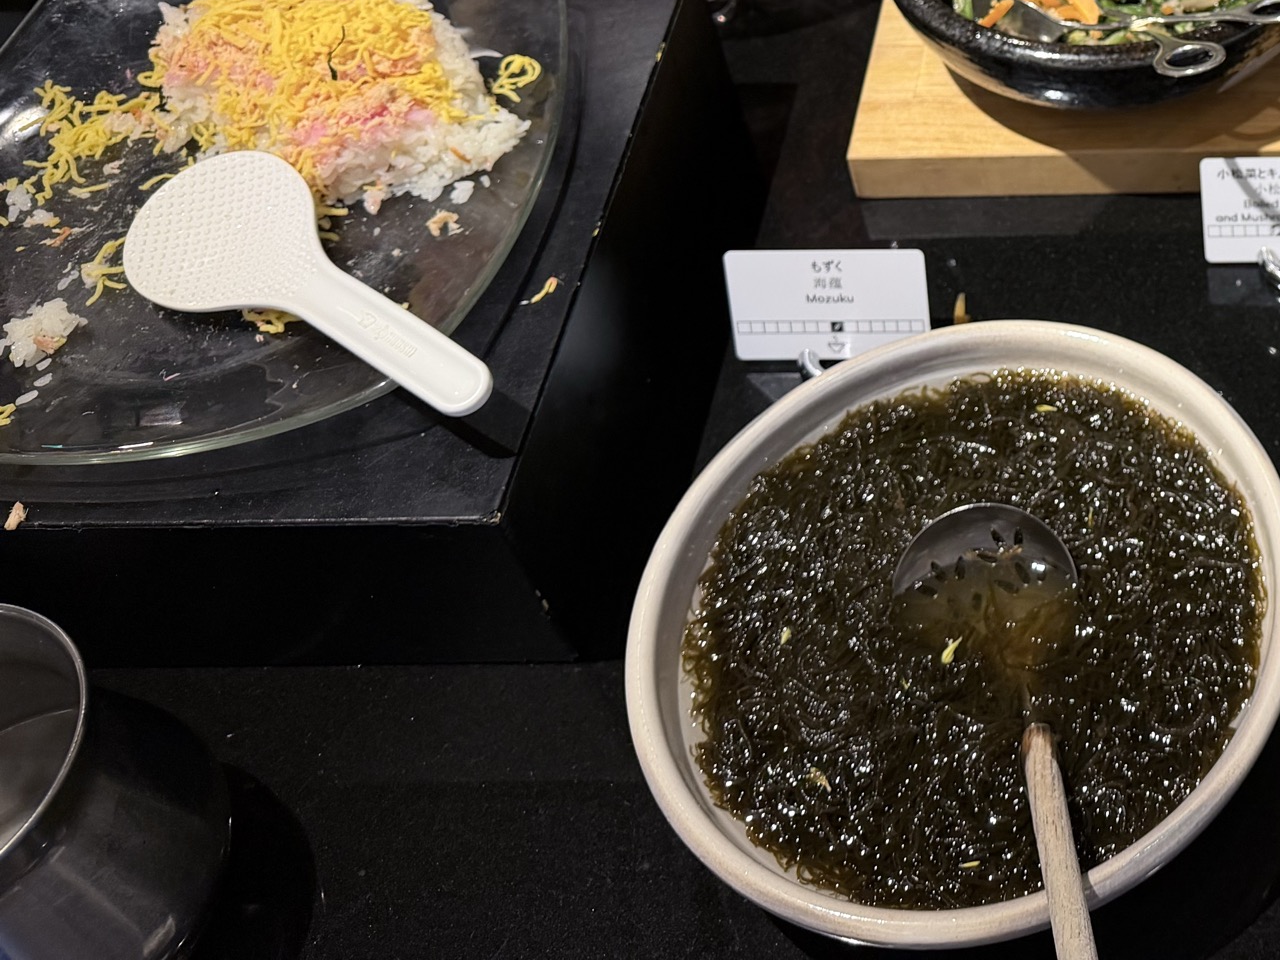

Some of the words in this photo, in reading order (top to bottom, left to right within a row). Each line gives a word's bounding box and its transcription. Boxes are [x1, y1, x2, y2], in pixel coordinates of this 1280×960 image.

[1215, 212, 1238, 222] and
[810, 260, 843, 273] もずく
[805, 293, 855, 304] Mozuku
